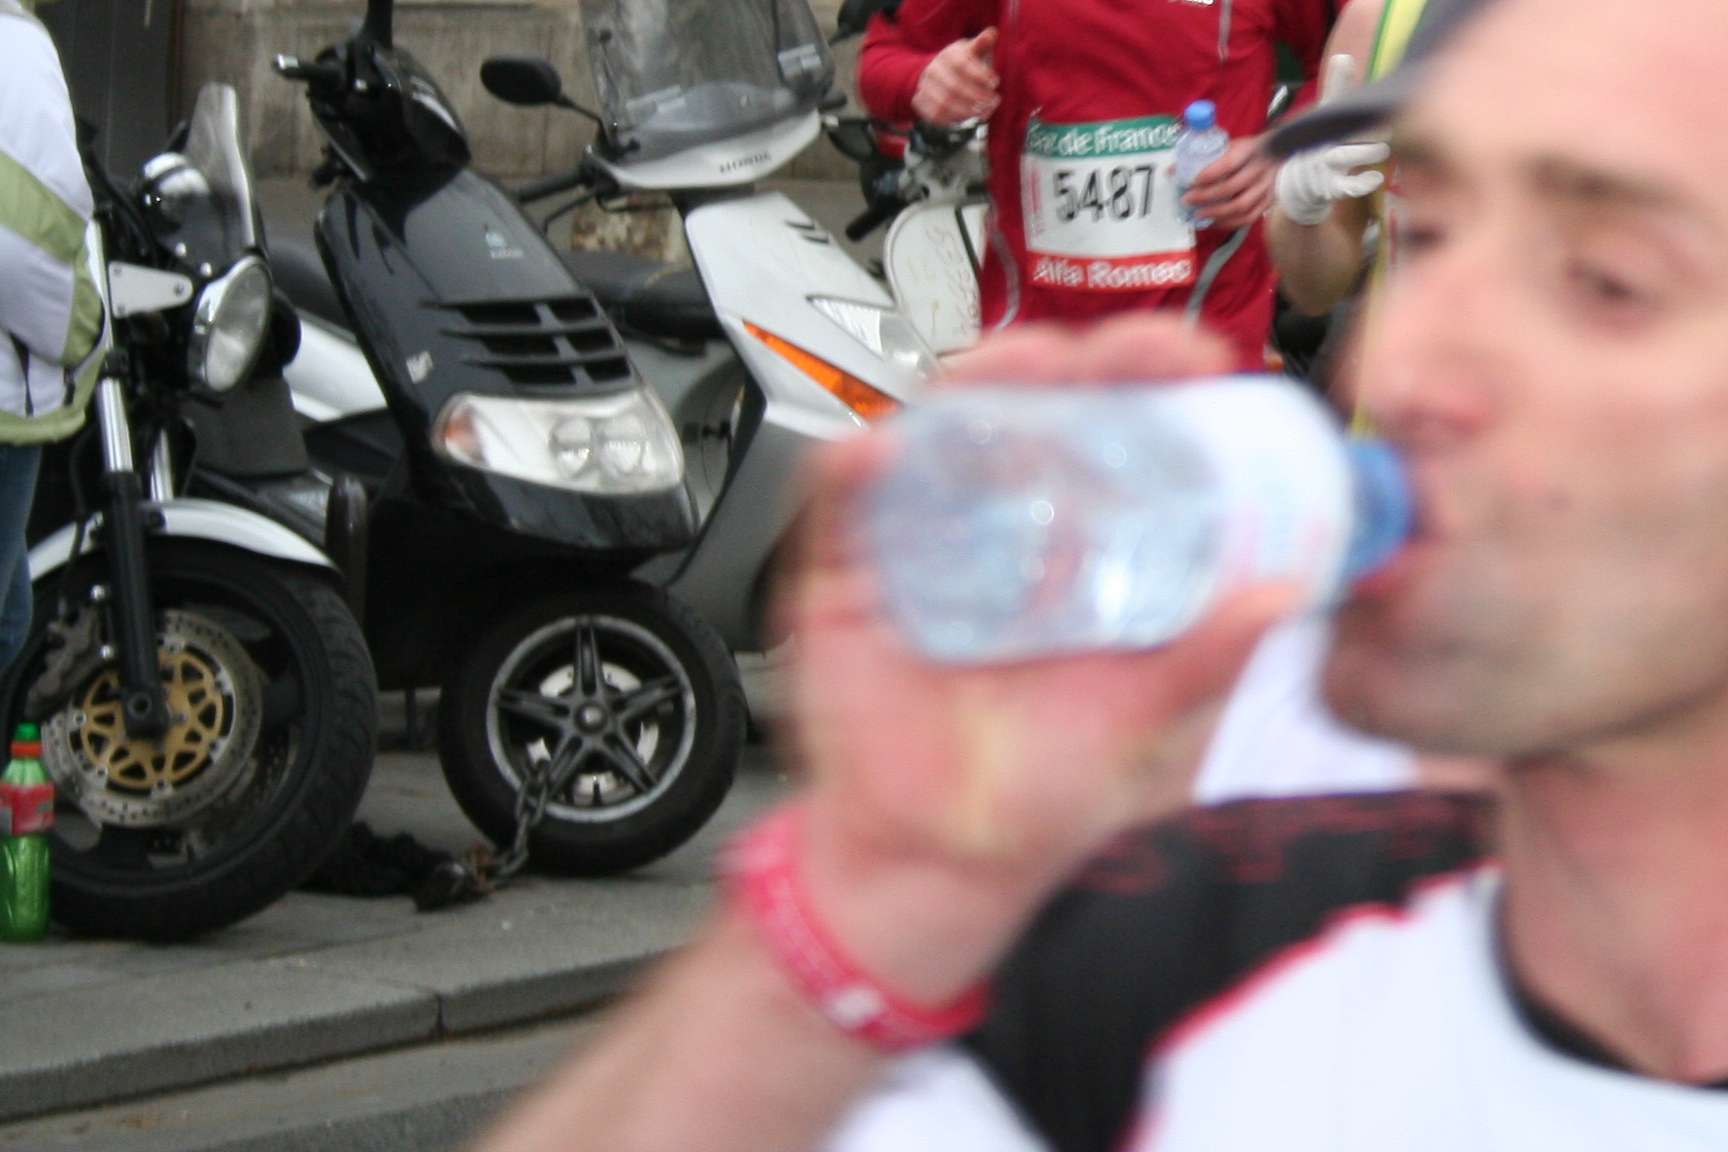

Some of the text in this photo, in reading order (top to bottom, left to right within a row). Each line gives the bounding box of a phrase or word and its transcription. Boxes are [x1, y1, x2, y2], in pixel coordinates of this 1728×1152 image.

[1058, 127, 1095, 156] de
[1055, 164, 1154, 224] 5487
[1033, 257, 1194, 290] Alfa Romeo
